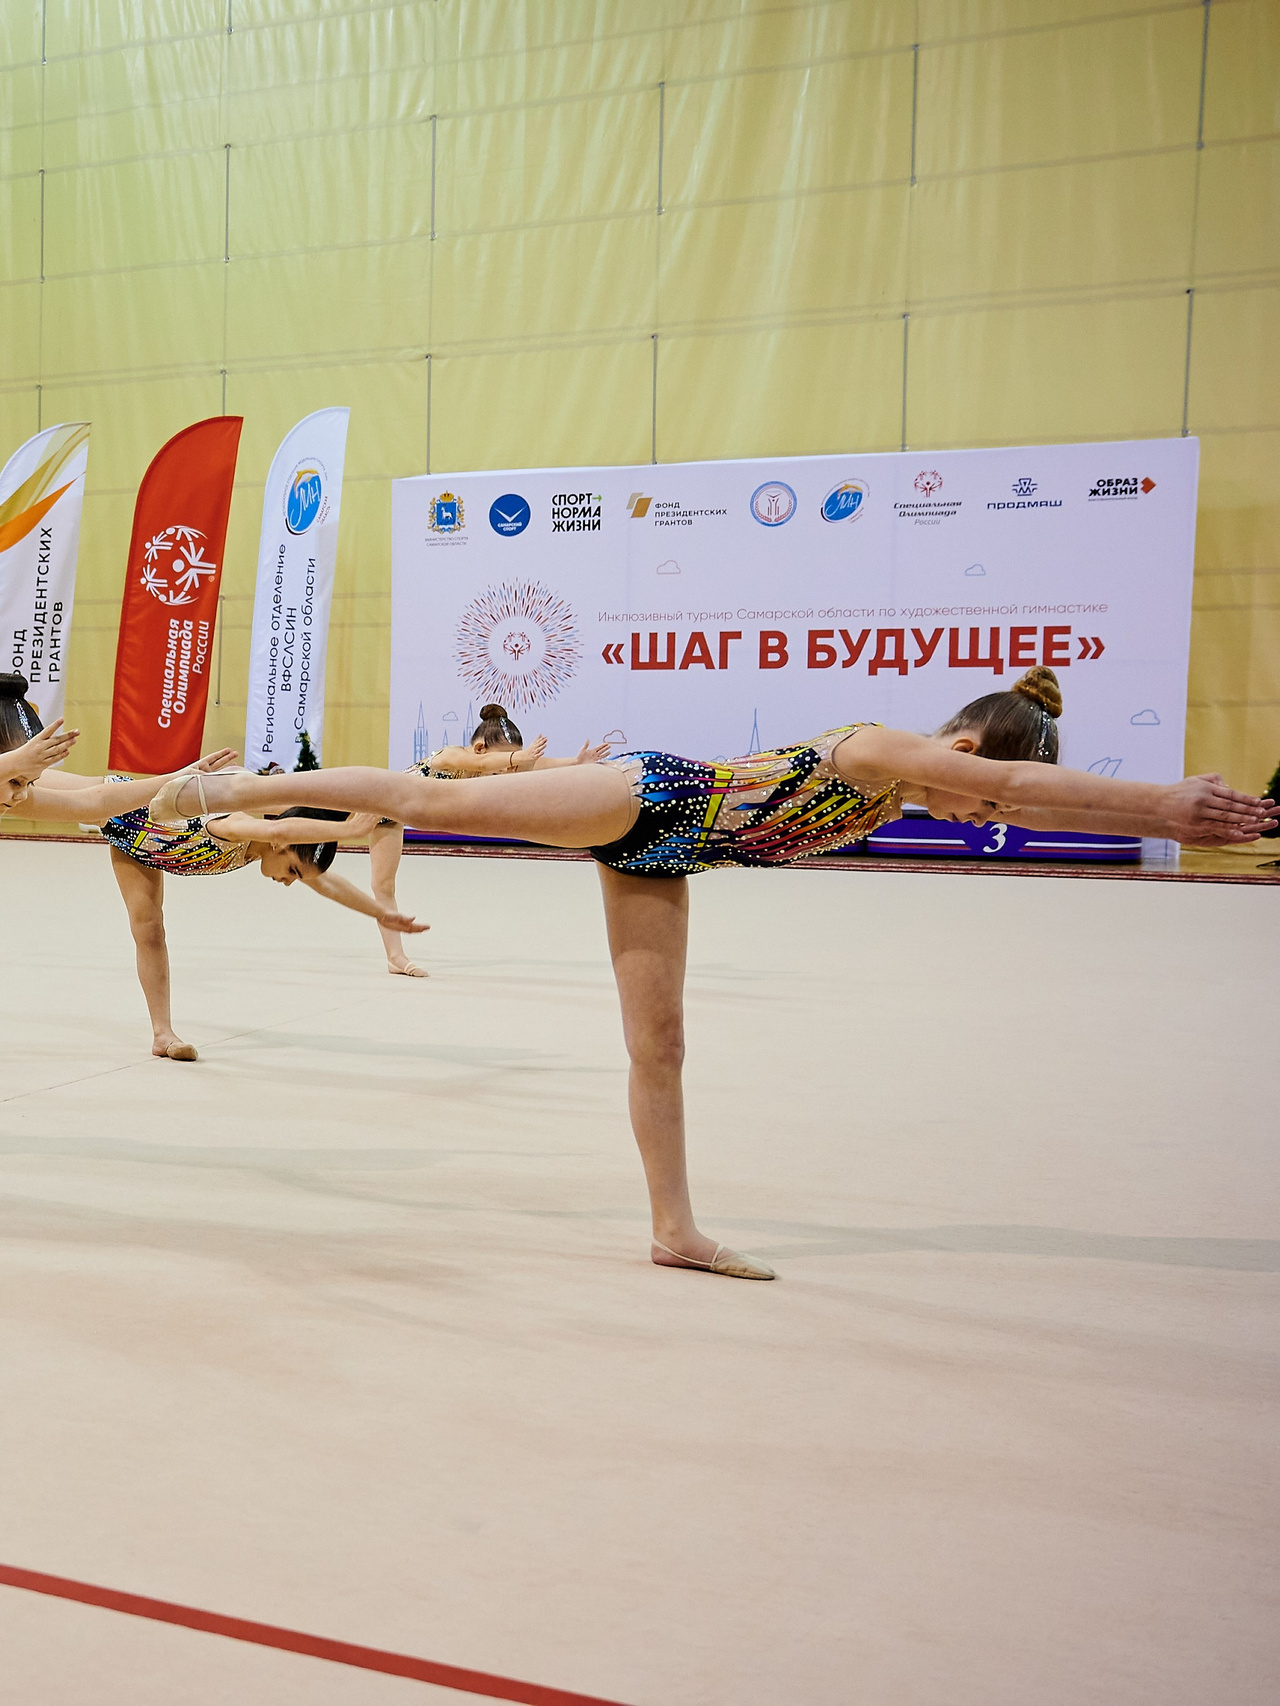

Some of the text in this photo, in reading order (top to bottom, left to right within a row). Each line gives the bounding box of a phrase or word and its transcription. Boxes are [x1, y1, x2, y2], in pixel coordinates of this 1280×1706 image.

[1088, 486, 1138, 497] ЖИЗНИ
[1096, 477, 1138, 487] ОБРАЗ
[551, 493, 593, 506] СПОРТ
[551, 505, 601, 519] НОРМА
[654, 501, 681, 509] ФОНД
[893, 500, 962, 509] Специальная
[551, 519, 601, 532] ЖИЗНИ
[654, 508, 728, 518] ПРЕЗИДЕНТСКИХ
[654, 518, 693, 526] ГРАНТОВ
[898, 509, 957, 518] Олимпиада
[914, 518, 941, 526] России
[300, 558, 316, 626] области
[29, 527, 53, 683] ПРЕЗИДЕНТСКИХ
[597, 602, 1109, 623] Инклюзивный турнир Самарской области по художественной гимнастике
[12, 628, 28, 675] ОНД
[48, 601, 63, 682] ГРАНТОВ
[192, 620, 210, 675] России
[262, 543, 286, 753] Региональное отделение
[280, 607, 297, 692] ВФСЛСИН
[601, 625, 1106, 676] «ШАГ В БУДУЩЕЕ»
[157, 618, 180, 729] Специальная
[172, 620, 194, 715] Олимпиада
[293, 632, 312, 730] Самарской
[982, 823, 1008, 853] 3
